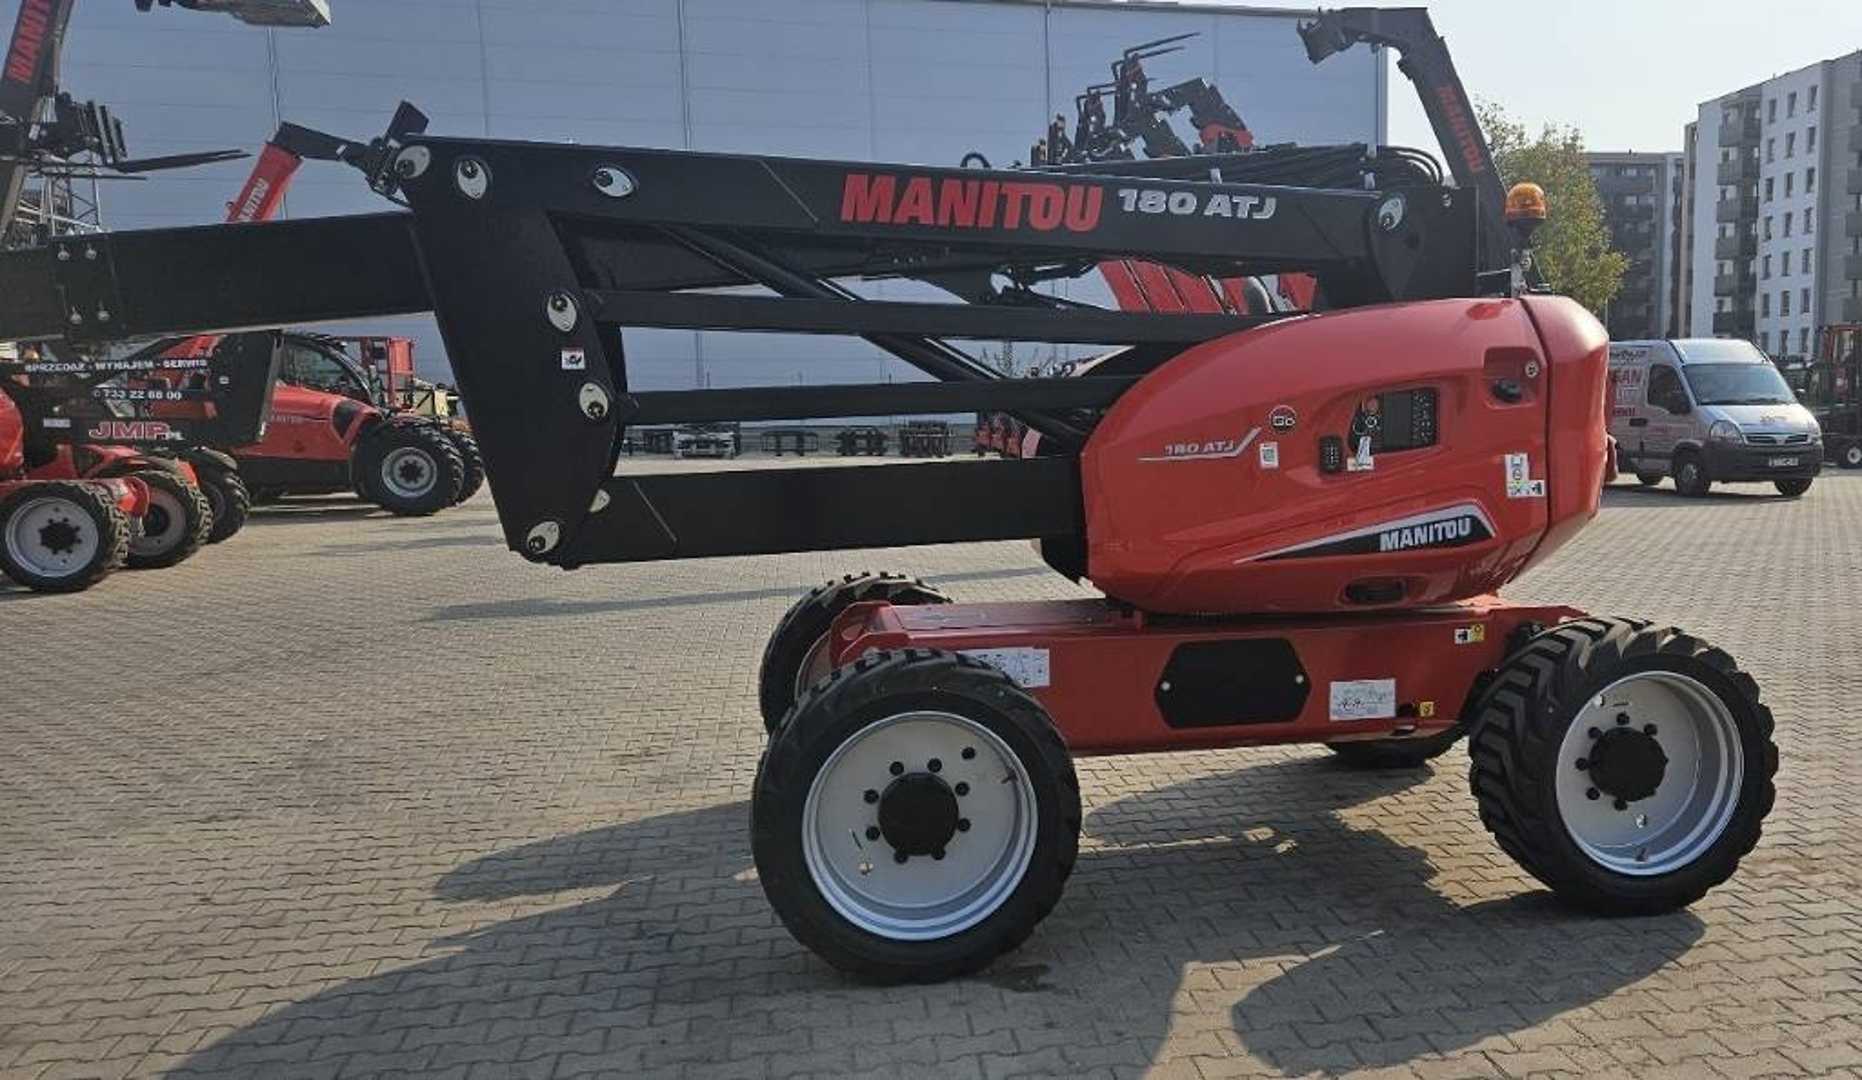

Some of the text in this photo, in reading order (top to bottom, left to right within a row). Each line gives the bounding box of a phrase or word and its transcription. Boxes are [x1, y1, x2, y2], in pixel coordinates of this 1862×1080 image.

[840, 173, 1103, 232] MANITOU
[1118, 188, 1277, 220] 180 ATJ
[88, 421, 170, 440] JMP
[1203, 440, 1234, 453] ATJ
[1380, 517, 1471, 551] MANITOU
